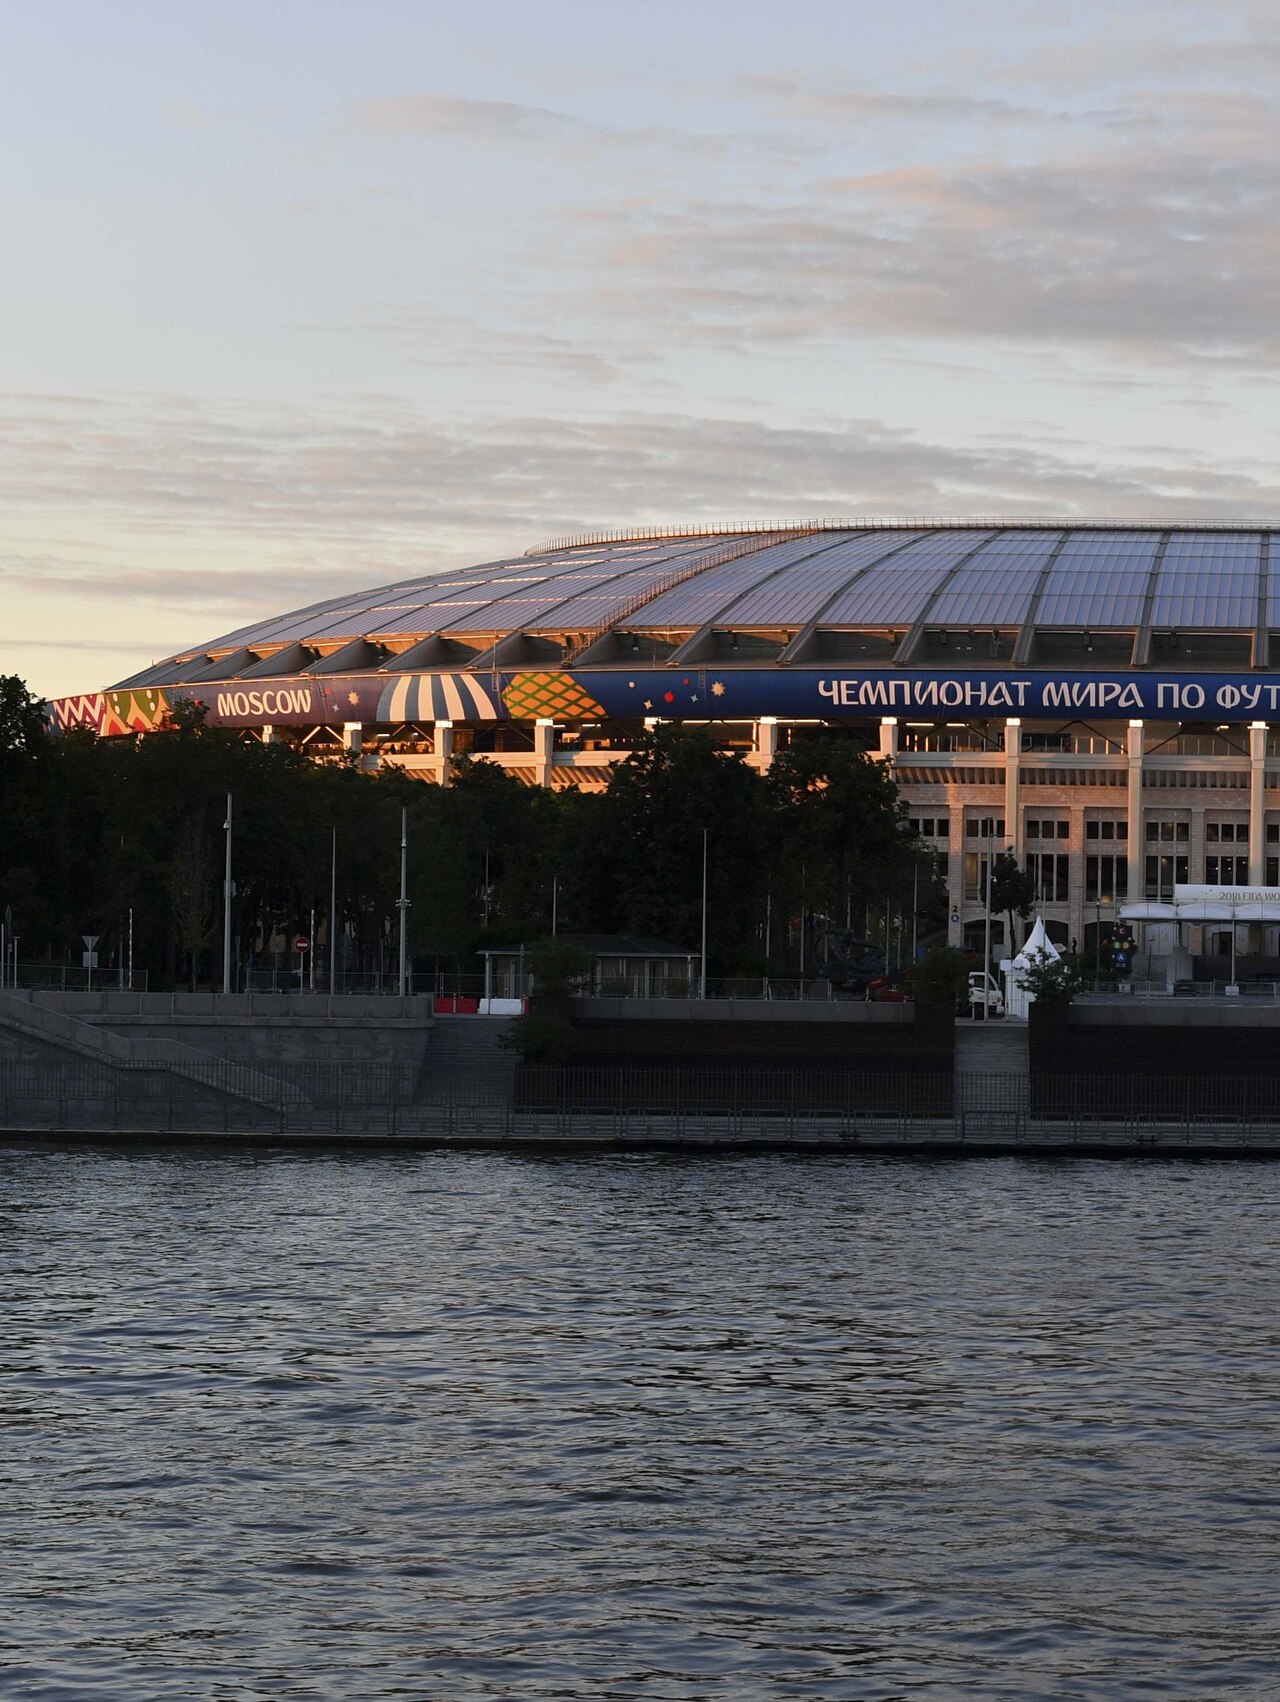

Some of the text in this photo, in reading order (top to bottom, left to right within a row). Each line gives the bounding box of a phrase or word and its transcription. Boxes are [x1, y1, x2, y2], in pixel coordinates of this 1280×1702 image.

[217, 689, 311, 717] MOSCOW
[818, 680, 1032, 706] ЧЕМПИОНАТ
[1042, 682, 1145, 708] МИРА
[1157, 683, 1206, 709] ПО
[1219, 892, 1241, 901] 2018
[1242, 892, 1263, 901] FIFA
